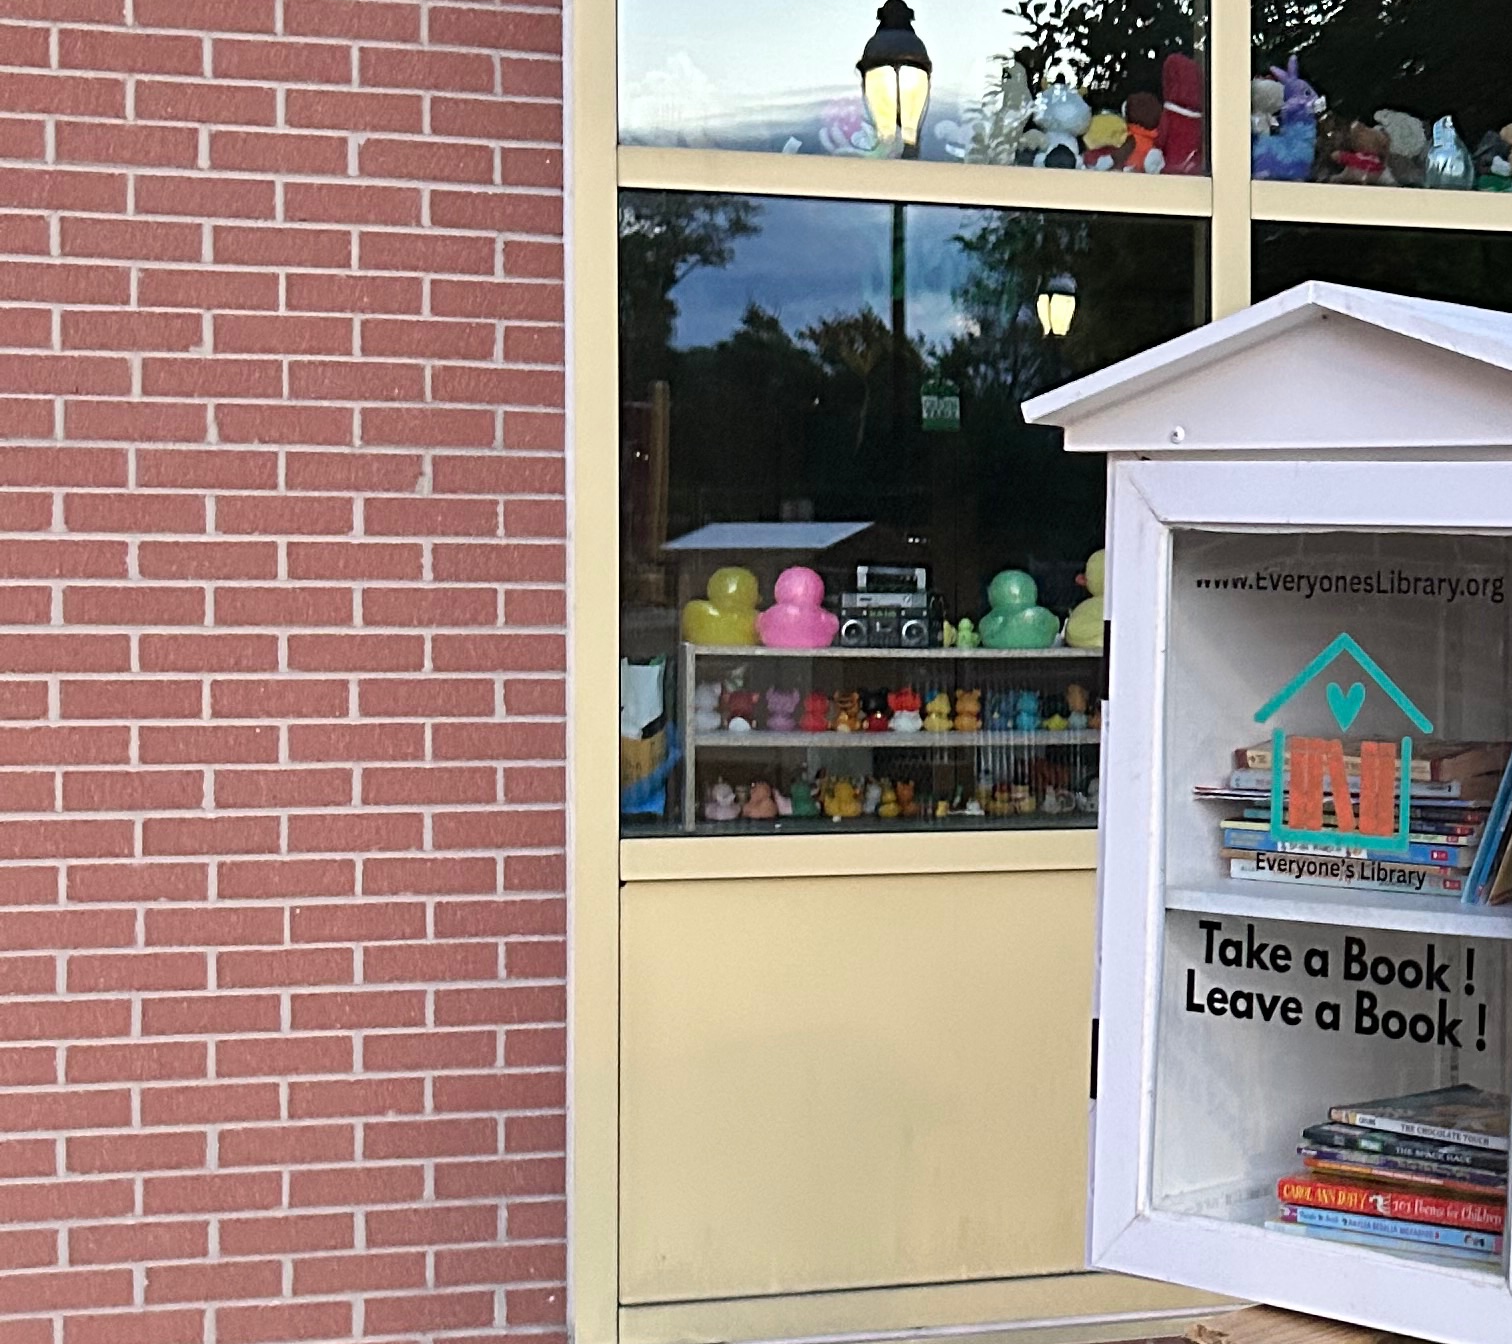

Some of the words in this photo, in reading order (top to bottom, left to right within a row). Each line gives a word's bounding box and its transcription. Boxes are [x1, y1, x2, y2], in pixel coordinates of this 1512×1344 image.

[1255, 852, 1355, 879] Everyone's
[1360, 860, 1427, 890] Library
[1199, 919, 1293, 973] Take
[1303, 947, 1330, 978] a
[1343, 935, 1451, 993] Book
[1185, 968, 1303, 1026] Leave
[1315, 1001, 1341, 1031] a
[1354, 989, 1463, 1048] Book
[1416, 1125, 1460, 1141] CHOCOLATE
[1392, 1199, 1412, 1214] 101
[1461, 1203, 1502, 1225] Children
